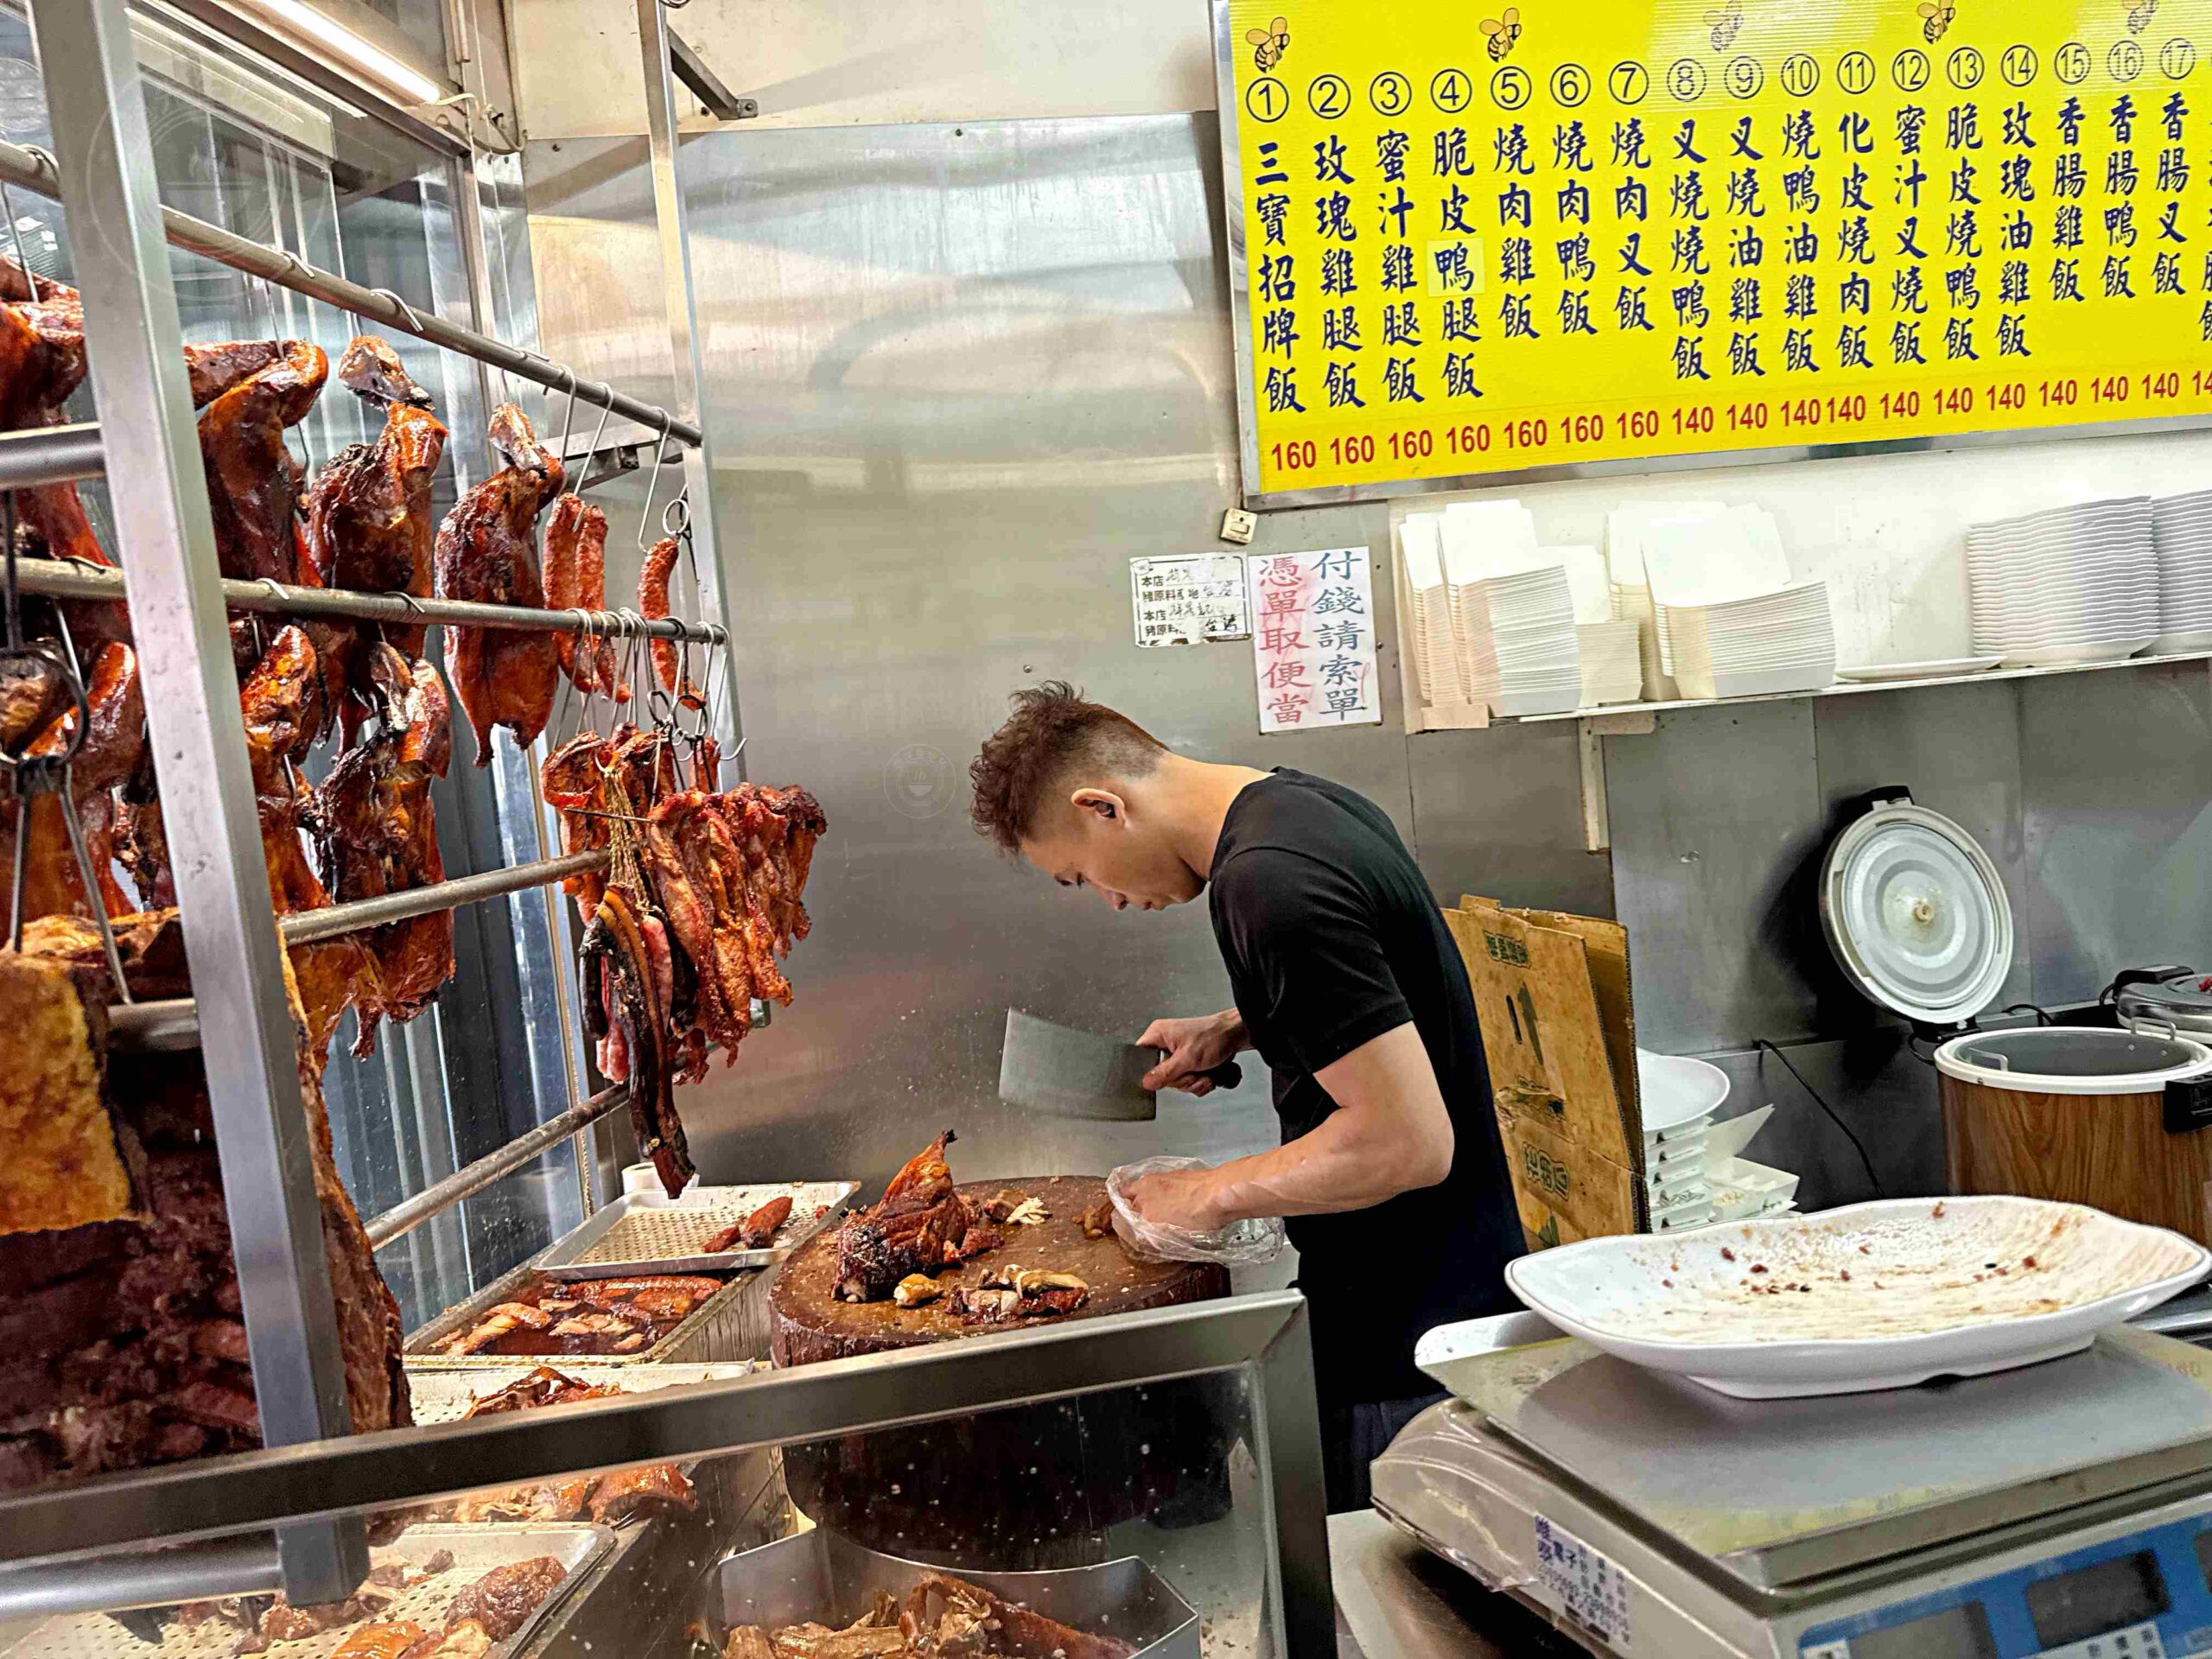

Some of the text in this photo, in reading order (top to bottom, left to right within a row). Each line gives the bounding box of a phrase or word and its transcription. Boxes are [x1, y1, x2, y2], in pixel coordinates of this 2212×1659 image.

[1255, 142, 1306, 413] 三寶招牌飯
[1313, 134, 1366, 409] 玫瑰雞腿飯
[1376, 129, 1425, 404] 蜜汁雞腿飯
[1433, 127, 1484, 398] 脆皮鴨腿飯
[1493, 123, 1541, 340] 燒肉雞飯
[1552, 120, 1599, 335] 燒肉鴨飯
[1611, 118, 1655, 331] 燒肉叉飯
[1669, 118, 1711, 381] 叉燒燒鴨飯
[1726, 116, 1766, 377] 叉燒油雞飯
[1782, 109, 1821, 372] 燒鴨油雞飯
[1836, 111, 1875, 369] 化皮燒肉飯
[1889, 104, 1929, 365] 蜜汁叉燒飯
[1943, 102, 1983, 361] 脆皮燒鴨飯
[1995, 101, 2037, 357] 玫瑰油雞飯
[2049, 96, 2088, 302] 香腸雞飯
[2101, 94, 2139, 299] 香腸鴨飯
[2151, 92, 2190, 296] 香腸叉飯
[1272, 441, 1316, 471] 160
[1330, 435, 1375, 465] 160
[1389, 429, 1433, 459] 160
[1446, 424, 1491, 454] 160
[1503, 419, 1548, 448] 160
[1561, 414, 1604, 443] 160
[1617, 410, 1659, 439] 160
[1672, 406, 1713, 435] 140
[1727, 403, 1768, 430] 140
[1781, 398, 1821, 427] 140
[1827, 395, 1866, 423] 140
[1880, 391, 1920, 417] 140
[1934, 387, 1973, 415] 140
[1986, 383, 2025, 410] 140
[2039, 379, 2077, 406] 140
[2091, 376, 2128, 402] 140
[2142, 372, 2179, 398] 140
[2192, 370, 2212, 396] 14
[1259, 555, 1313, 724] 憑單取便當
[1310, 550, 1368, 721] 付錢請索單
